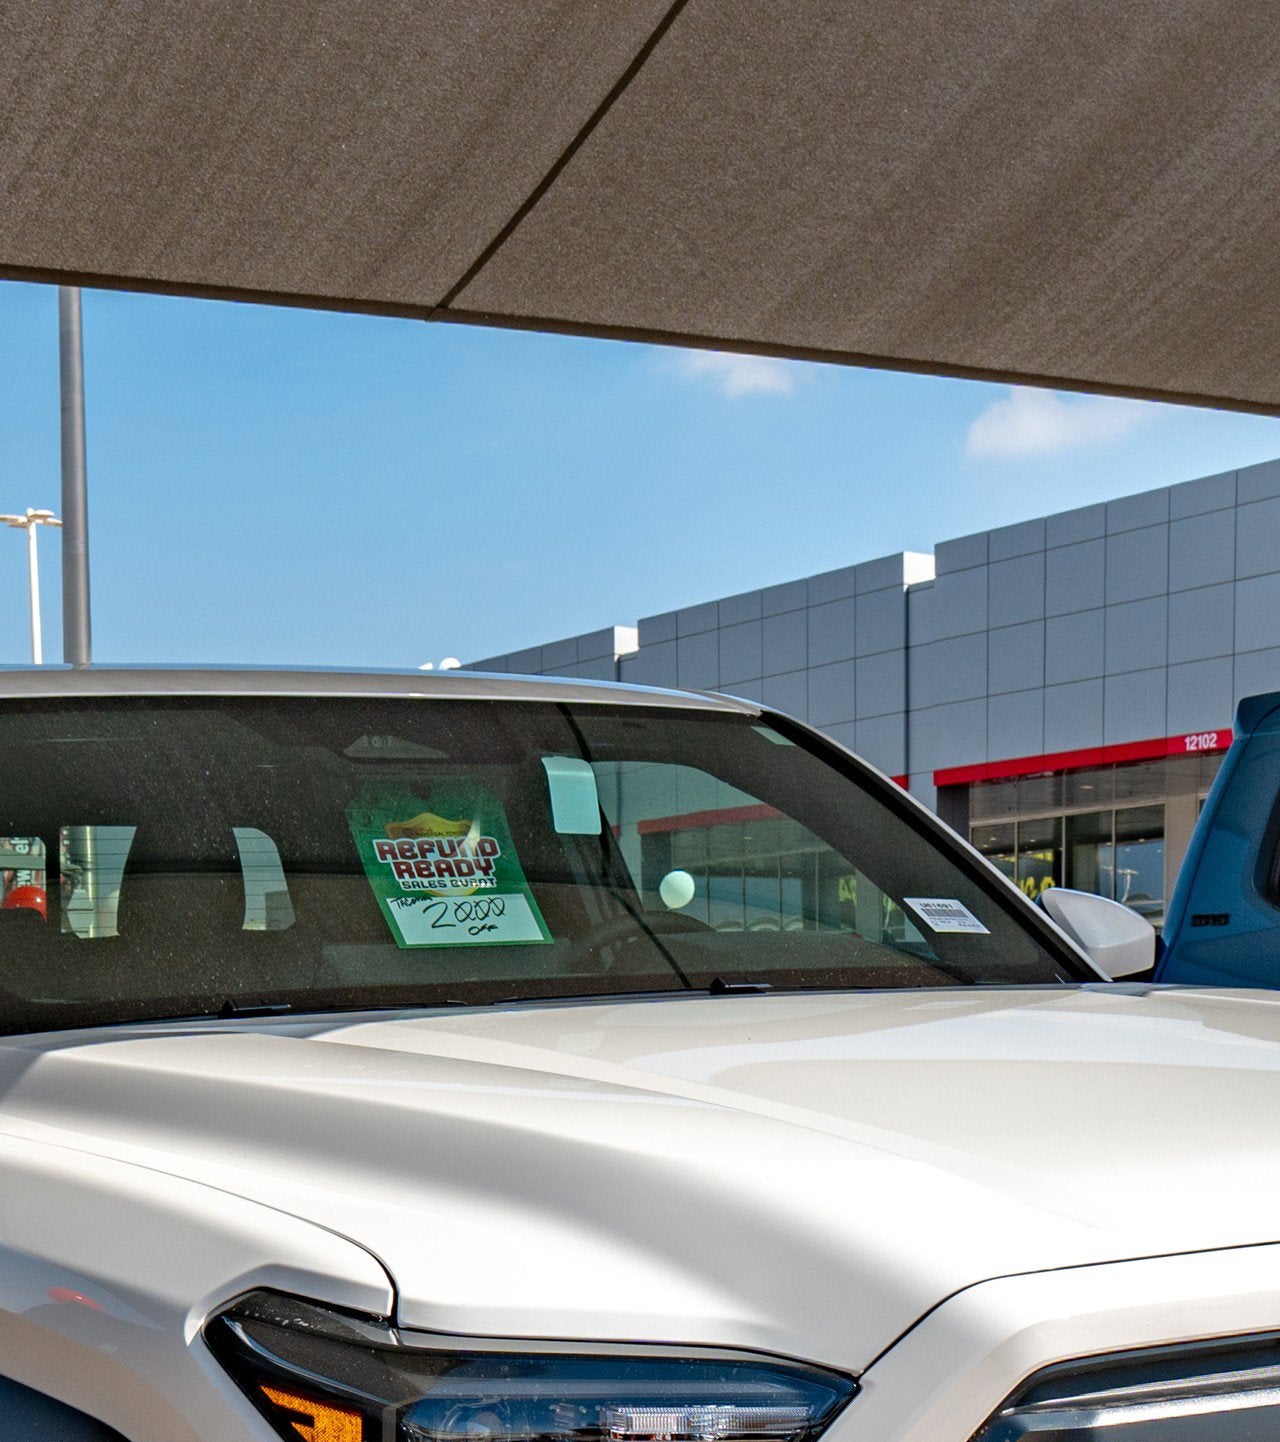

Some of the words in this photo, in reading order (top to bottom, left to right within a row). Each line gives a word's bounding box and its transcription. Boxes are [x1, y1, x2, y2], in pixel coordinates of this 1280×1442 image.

[1184, 731, 1218, 752] 12102
[392, 858, 494, 880] READY
[423, 897, 506, 929] 2000
